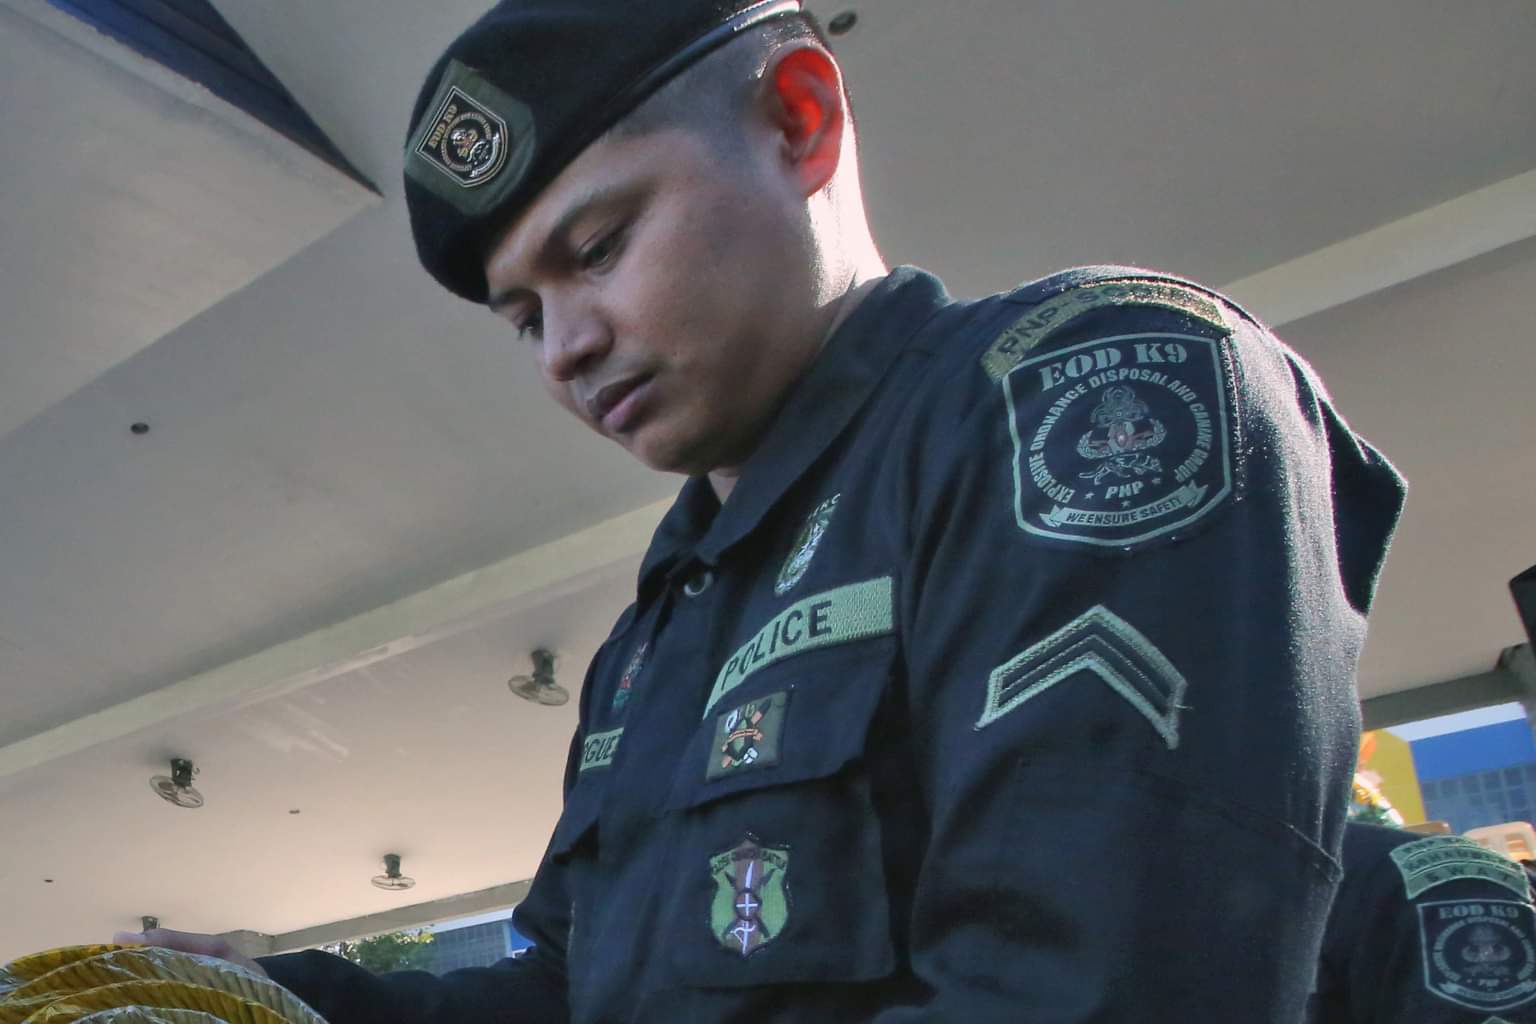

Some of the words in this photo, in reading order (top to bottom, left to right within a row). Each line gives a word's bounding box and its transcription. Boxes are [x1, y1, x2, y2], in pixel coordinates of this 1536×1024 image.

[998, 307, 1059, 354] PNP
[1039, 347, 1121, 392] EOD
[1133, 343, 1188, 364] K9
[1089, 367, 1168, 388] DISPOSAL
[1167, 379, 1196, 403] AND
[1030, 384, 1088, 451] ORDNANCE
[1189, 402, 1212, 450] CANINE
[1029, 452, 1075, 504] EXPLOSIVE
[1174, 448, 1209, 482] GROUP
[1105, 481, 1144, 499] PNP
[721, 600, 833, 691] POLICE
